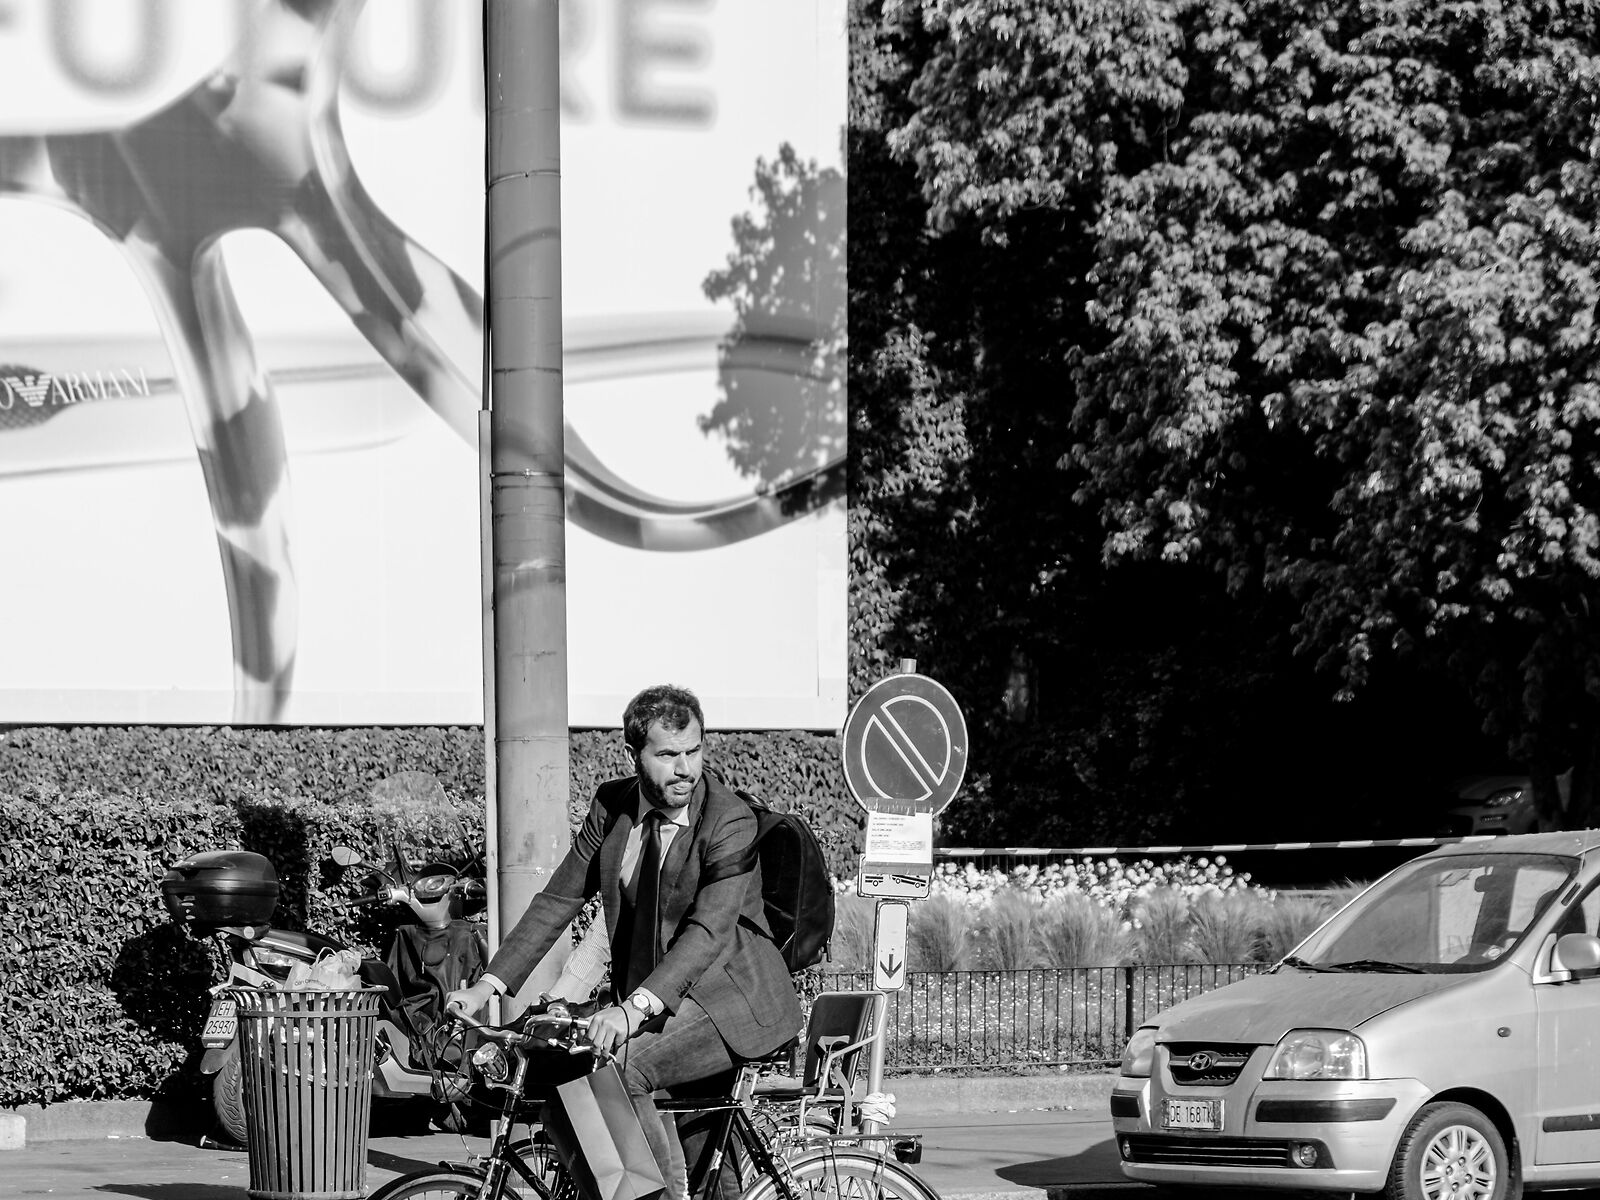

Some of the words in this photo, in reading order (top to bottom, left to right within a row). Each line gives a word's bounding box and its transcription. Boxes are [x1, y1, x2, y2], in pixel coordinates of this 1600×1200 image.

[0, 0, 717, 129] UUE
[51, 367, 150, 405] ARMANI
[217, 1002, 232, 1016] EH
[205, 1020, 235, 1035] 25930
